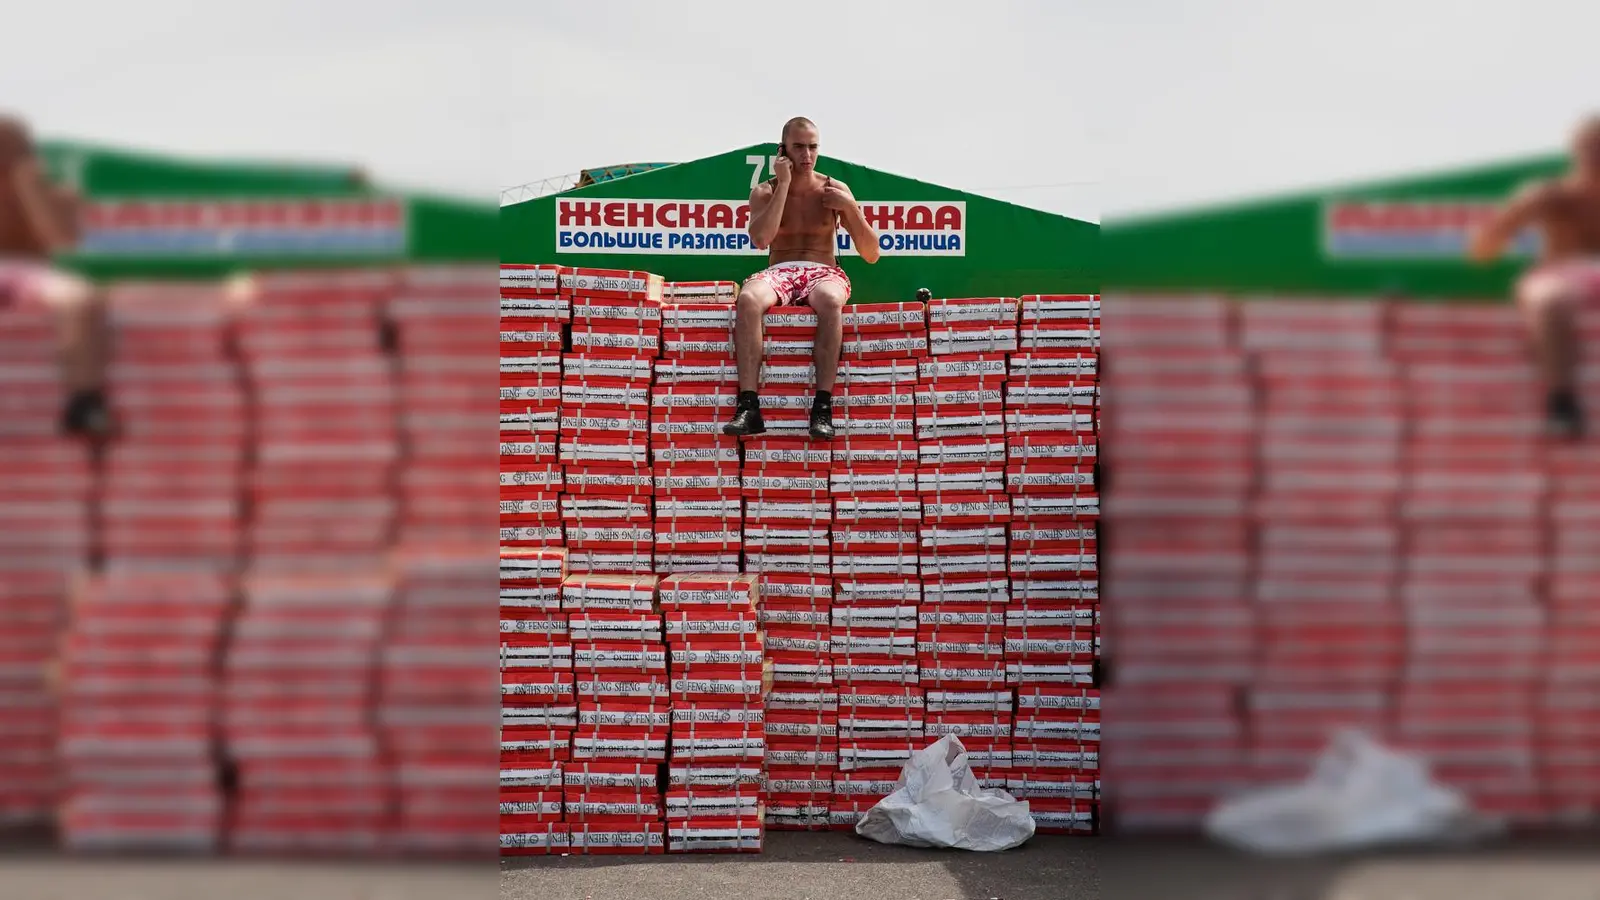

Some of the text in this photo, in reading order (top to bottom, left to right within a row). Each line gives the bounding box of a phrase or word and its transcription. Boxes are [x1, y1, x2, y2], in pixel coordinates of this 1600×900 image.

[559, 202, 961, 230] ЖЕНСКАЯ ЖДА
[559, 231, 662, 249] БОЛЬШИЕ
[878, 234, 961, 251] ОЗНИЦА
[594, 280, 619, 290] SHENG
[602, 308, 627, 316] SHENG
[766, 315, 790, 324] SHENG
[577, 337, 623, 346] FENG SHNG
[946, 362, 969, 372] SHENG
[542, 388, 557, 397] ENG
[956, 392, 974, 402] FENG
[978, 390, 1003, 402] HENG
[674, 396, 692, 406] FENG
[852, 396, 876, 406] SHENG
[590, 418, 608, 428] FENG
[670, 424, 714, 433] FENG SHENG
[501, 444, 520, 453] FENG
[1031, 446, 1056, 454] SHENG
[674, 450, 692, 458] FENG
[782, 453, 801, 461] FENG
[804, 453, 828, 462] HENG
[524, 472, 544, 482] FENG
[1028, 475, 1074, 484] FENG SHENG
[686, 478, 710, 486] SHENG
[788, 479, 812, 488] SHENG
[962, 502, 980, 512] FENG
[538, 528, 557, 537] FNG
[594, 531, 640, 540] FNG SHENG
[678, 532, 696, 540] FENG
[869, 532, 889, 540] FENG
[1039, 531, 1063, 540] SHENG
[785, 584, 804, 593] FENG
[691, 590, 712, 600] FENG
[959, 613, 983, 622] SHENG
[528, 621, 548, 630] FENG
[710, 621, 730, 631] FENG
[924, 642, 970, 652] FEG SHENG
[1023, 642, 1048, 652] HENG
[704, 652, 729, 662] SHENG
[956, 669, 975, 678] FENG
[614, 682, 640, 691] SHENG
[687, 682, 734, 692] FENG SHENG
[856, 696, 880, 704] SHENG
[1034, 697, 1080, 706] FENG SHEN
[700, 711, 719, 721] FENG
[738, 712, 764, 721] SHEG
[784, 752, 808, 761] SHENG
[624, 777, 650, 787] SHNG
[614, 804, 641, 814] HENG
[505, 834, 526, 844] FENG
[586, 834, 609, 844] SHEN
[612, 834, 632, 844] FENG
